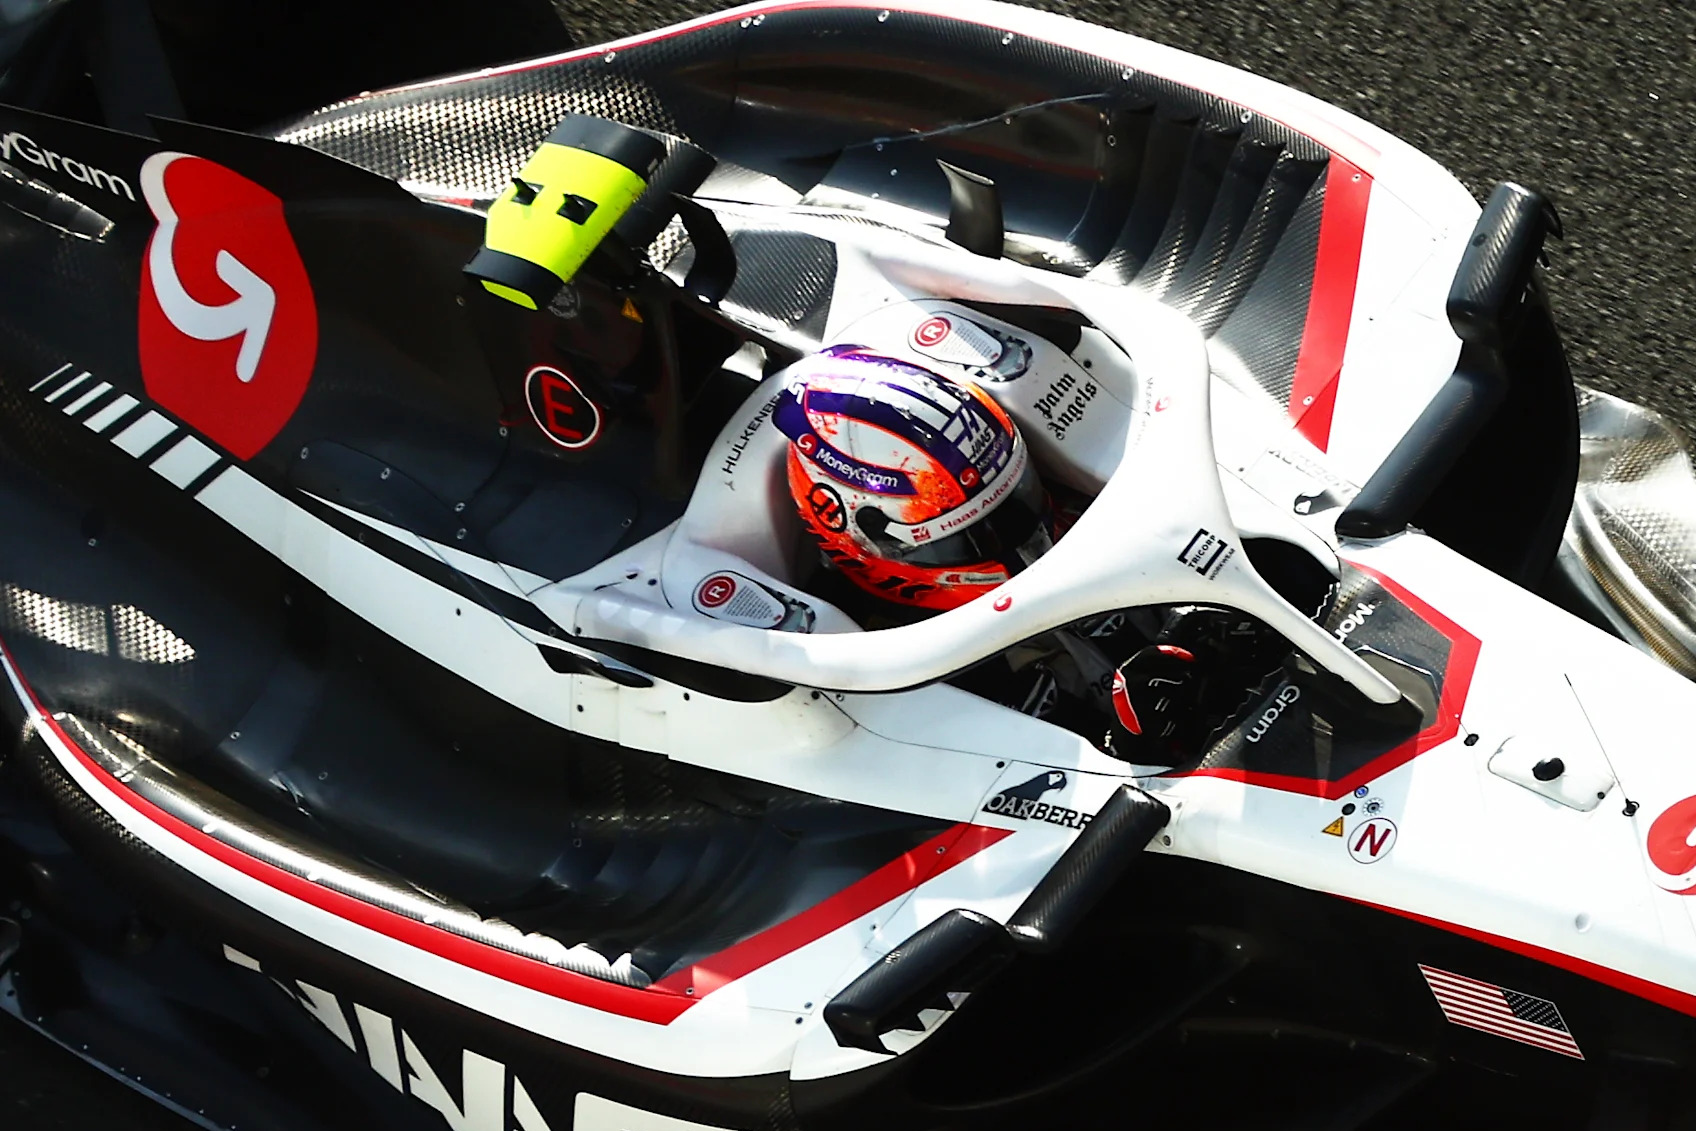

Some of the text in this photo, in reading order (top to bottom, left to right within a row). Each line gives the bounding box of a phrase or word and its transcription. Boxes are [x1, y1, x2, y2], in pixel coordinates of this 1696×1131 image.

[540, 373, 584, 440] E
[1033, 373, 1077, 419] Palm
[1047, 381, 1098, 440] Angels
[816, 447, 898, 488] MoneyGram
[940, 508, 979, 531] Haas
[1187, 535, 1216, 568] TRICORP
[983, 793, 1096, 830] OAKBERR
[1354, 823, 1392, 857] N
